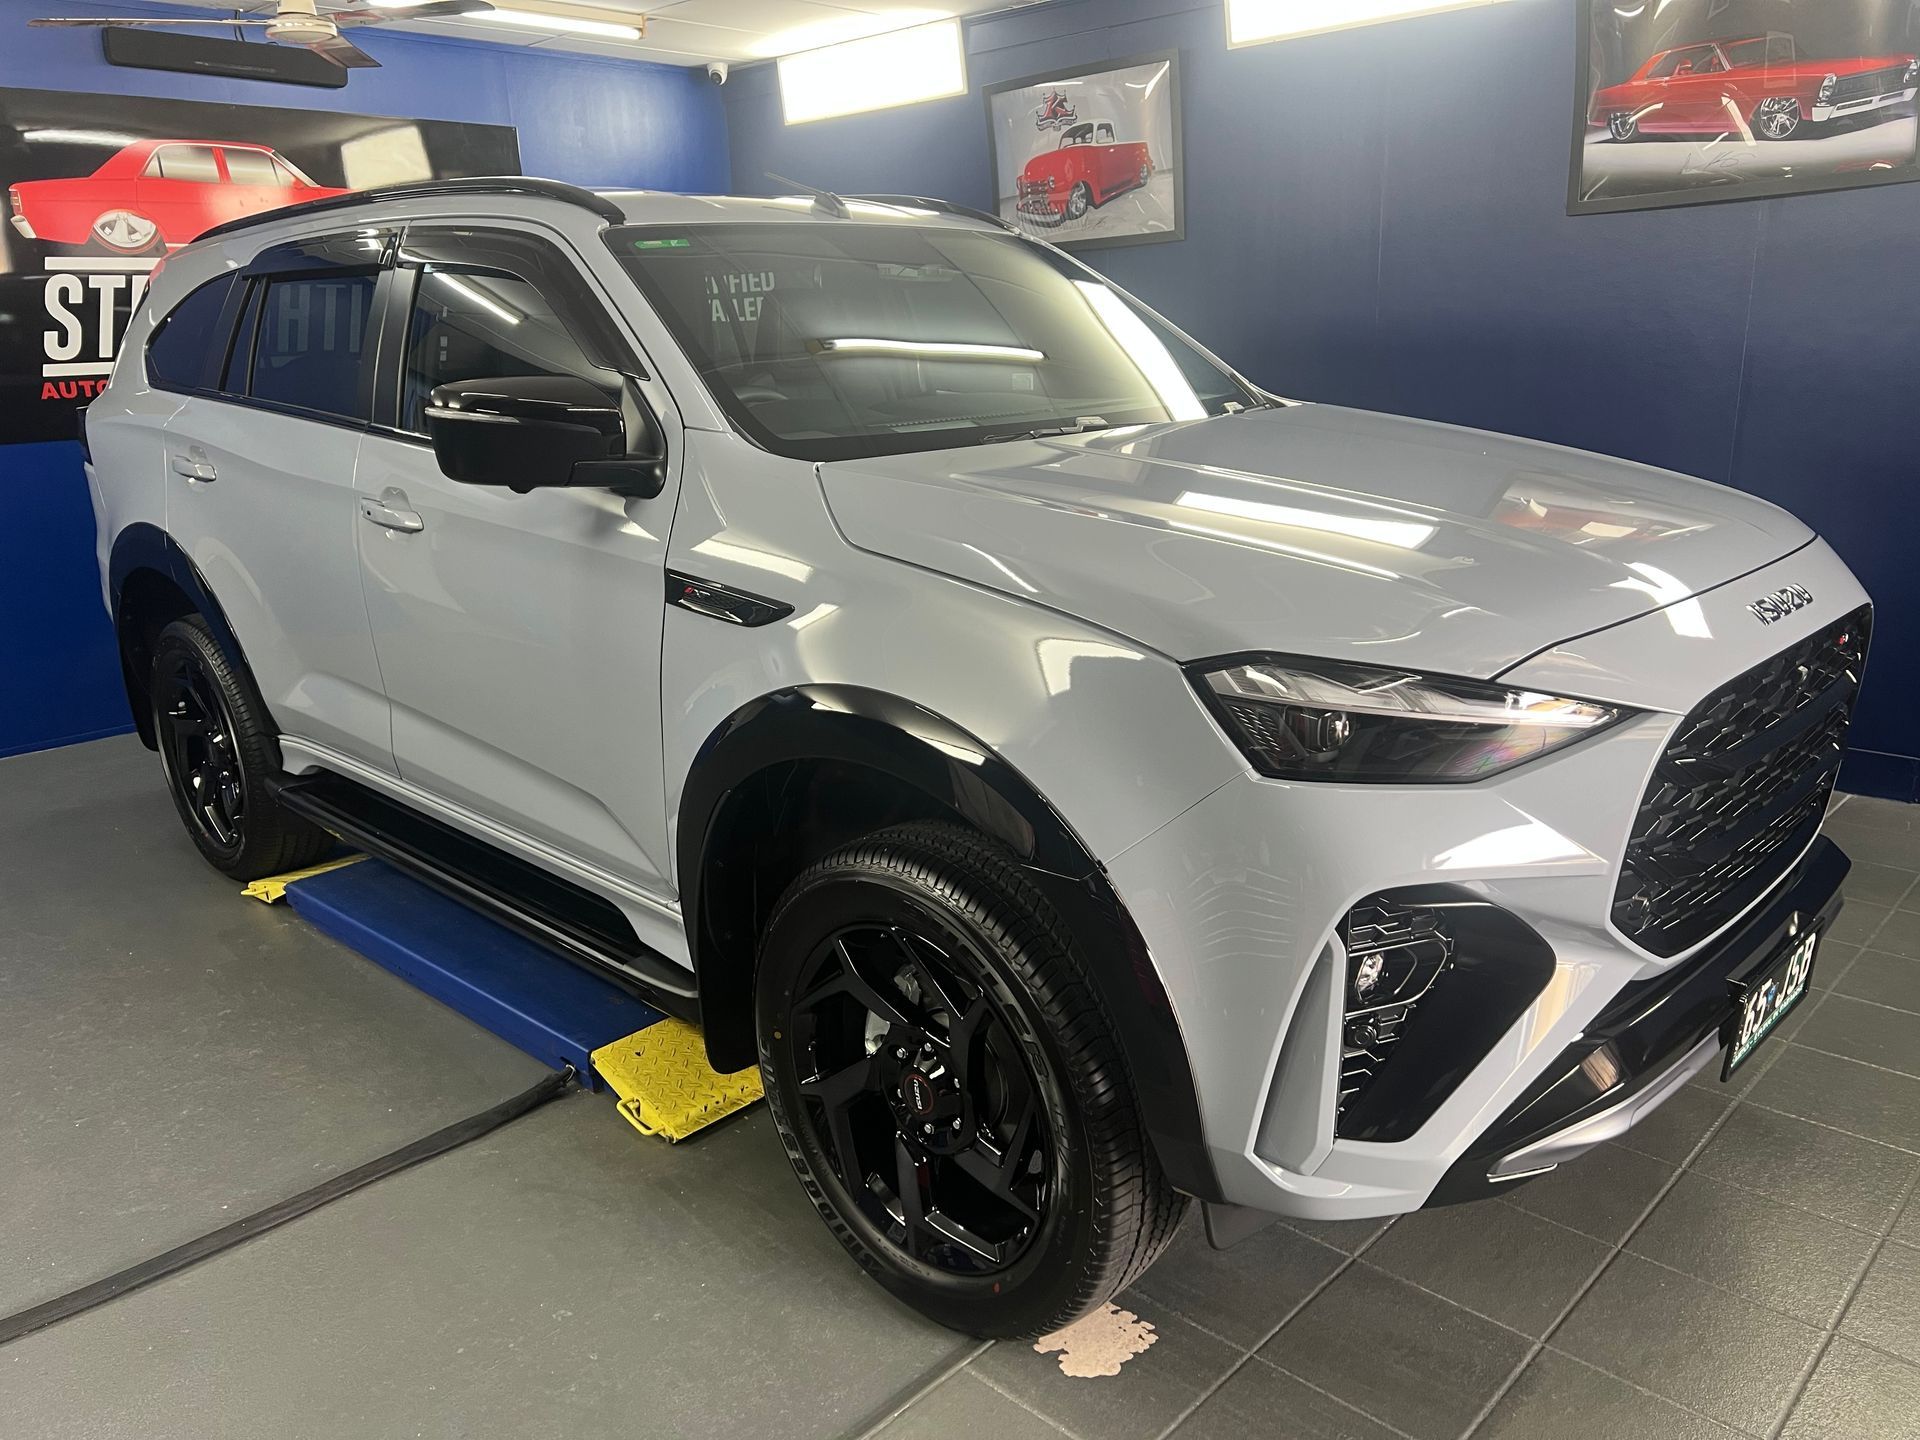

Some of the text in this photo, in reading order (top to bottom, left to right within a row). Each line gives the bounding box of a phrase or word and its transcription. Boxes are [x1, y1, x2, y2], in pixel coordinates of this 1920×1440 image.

[44, 273, 150, 361] ST
[1745, 583, 1813, 626] ISUZU
[1742, 978, 1773, 1045] 65
[1775, 932, 1816, 1009] JSB
